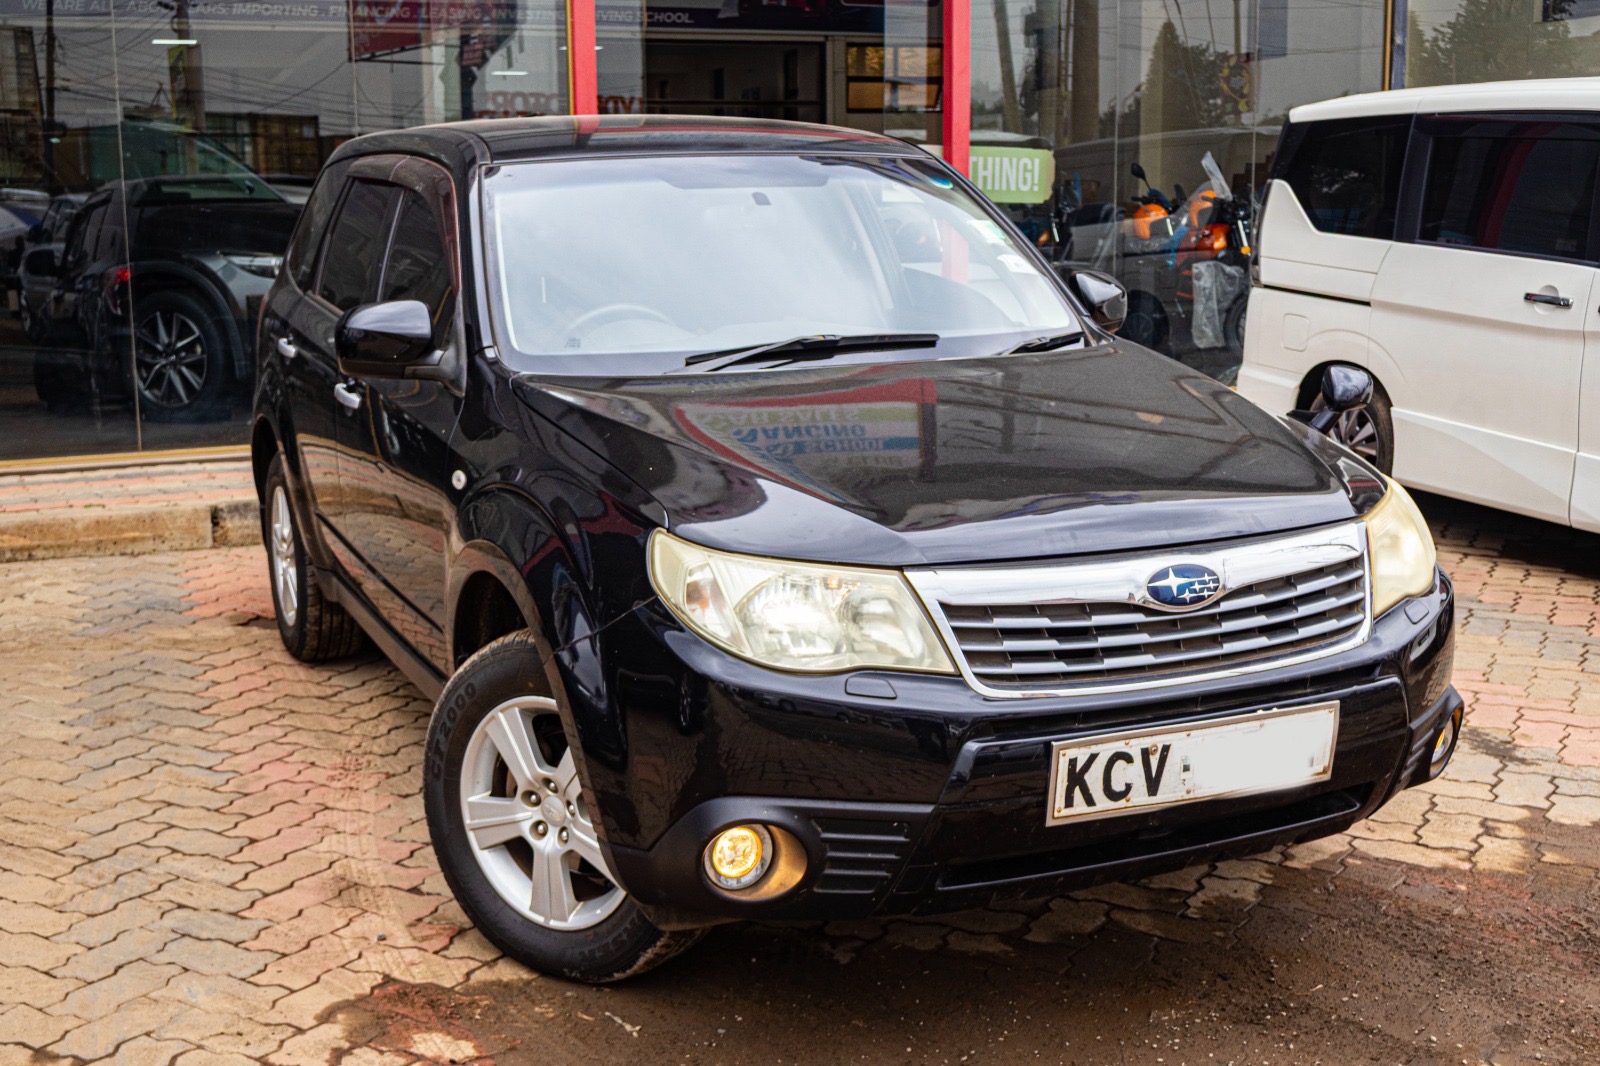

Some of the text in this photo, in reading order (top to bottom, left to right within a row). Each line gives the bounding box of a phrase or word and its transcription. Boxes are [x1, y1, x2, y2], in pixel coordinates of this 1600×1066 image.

[53, 0, 85, 12] ARE
[232, 4, 318, 17] IMPORTING
[421, 7, 482, 20] LEASING
[1064, 743, 1172, 808] KCV
